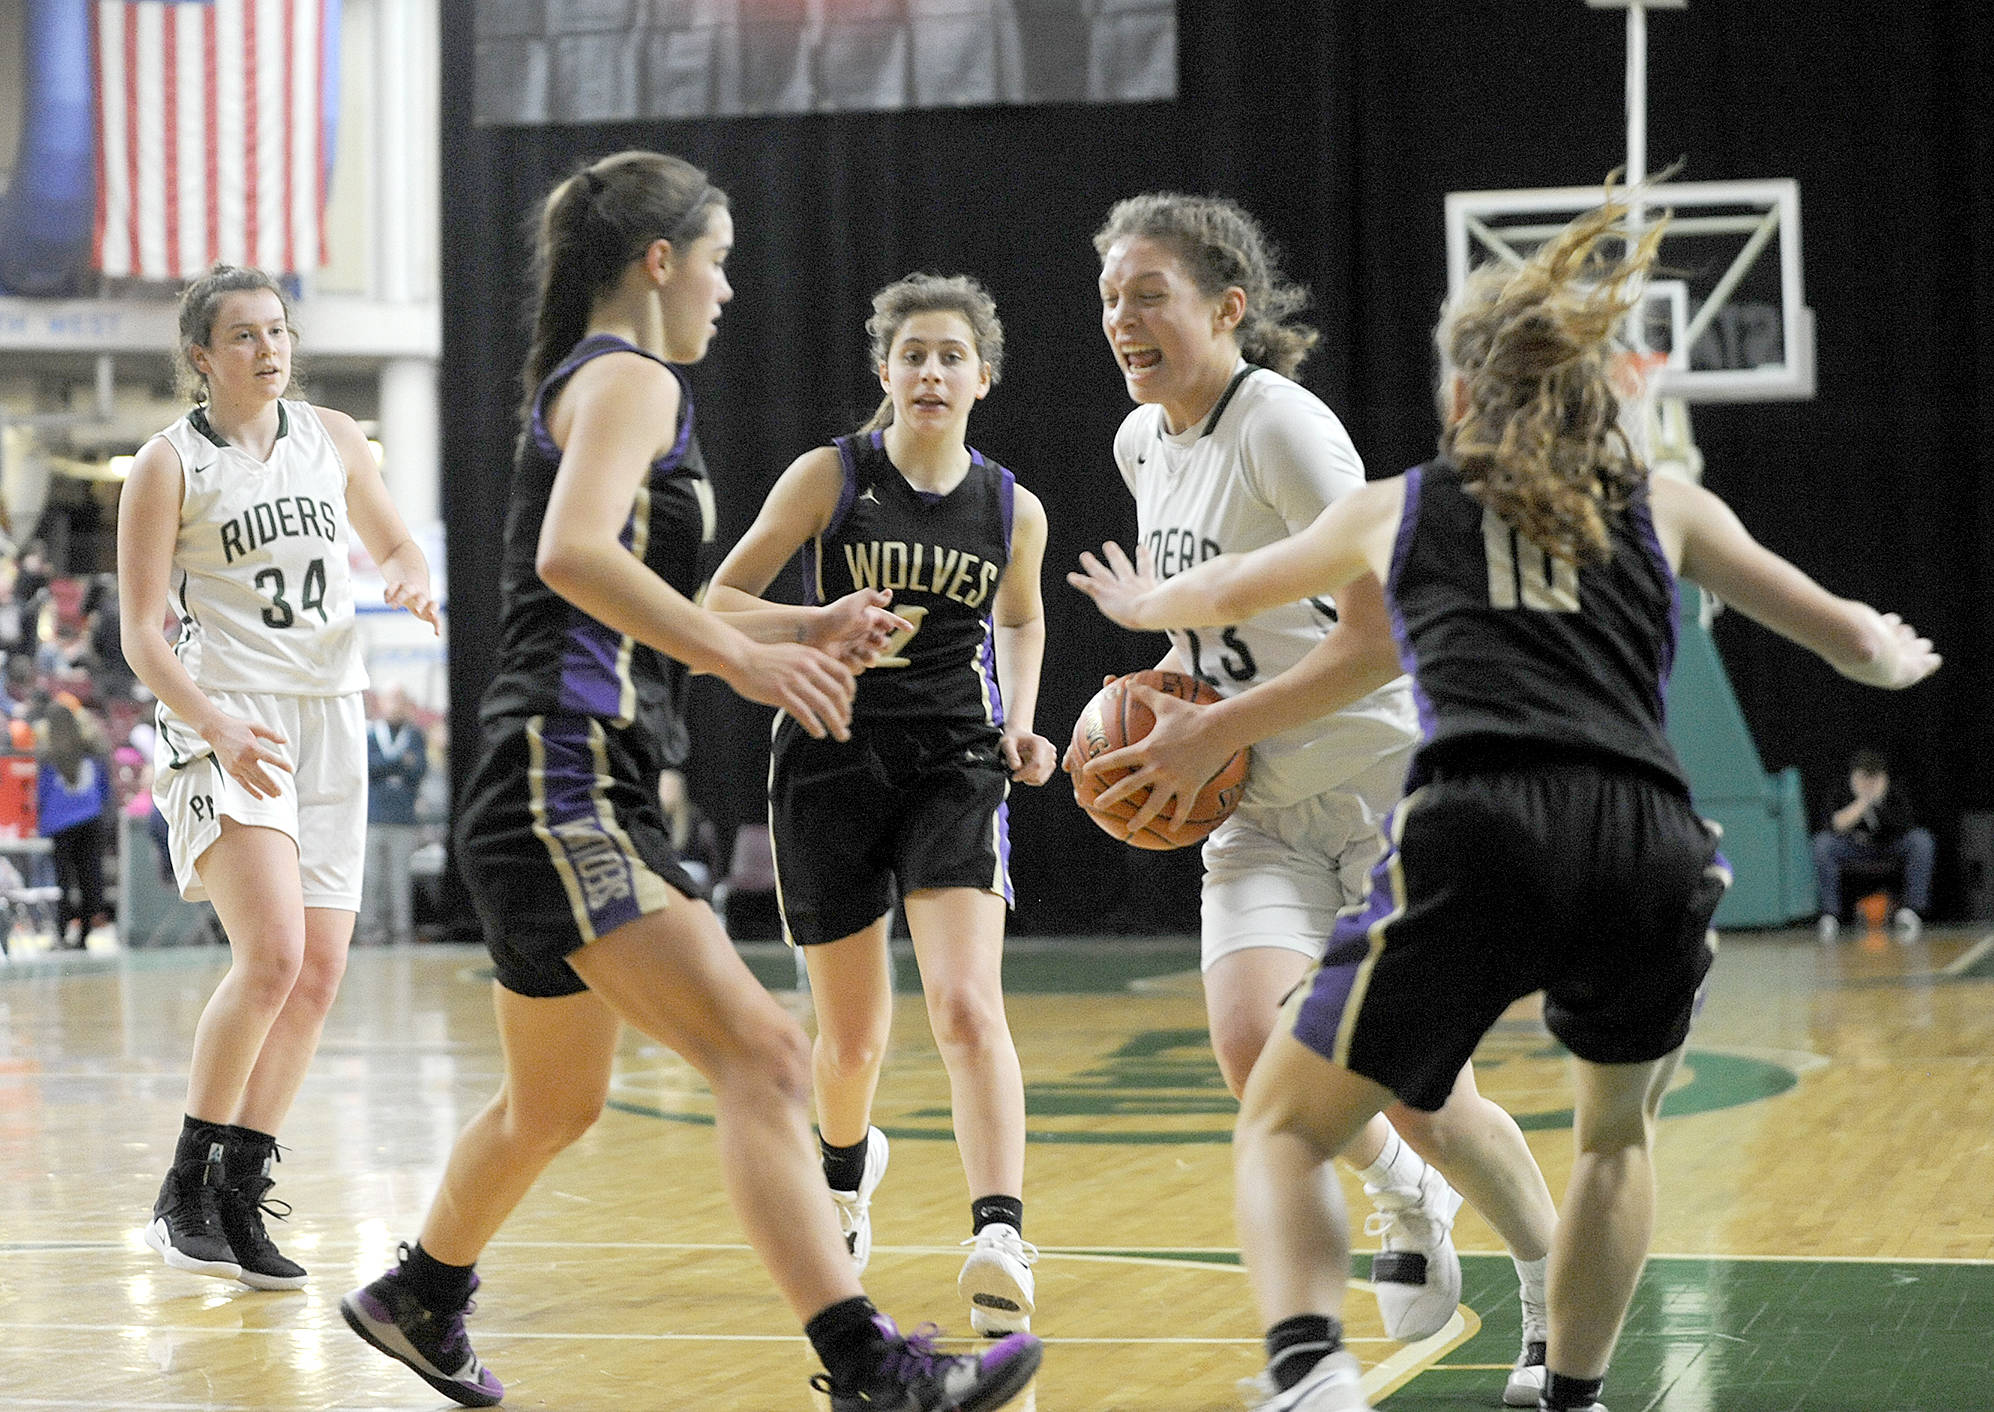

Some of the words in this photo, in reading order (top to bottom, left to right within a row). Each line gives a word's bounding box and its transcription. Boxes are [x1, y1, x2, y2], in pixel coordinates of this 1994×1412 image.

[220, 496, 335, 564] RIDERS
[254, 558, 328, 629] 34
[844, 541, 999, 609] WOLVES
